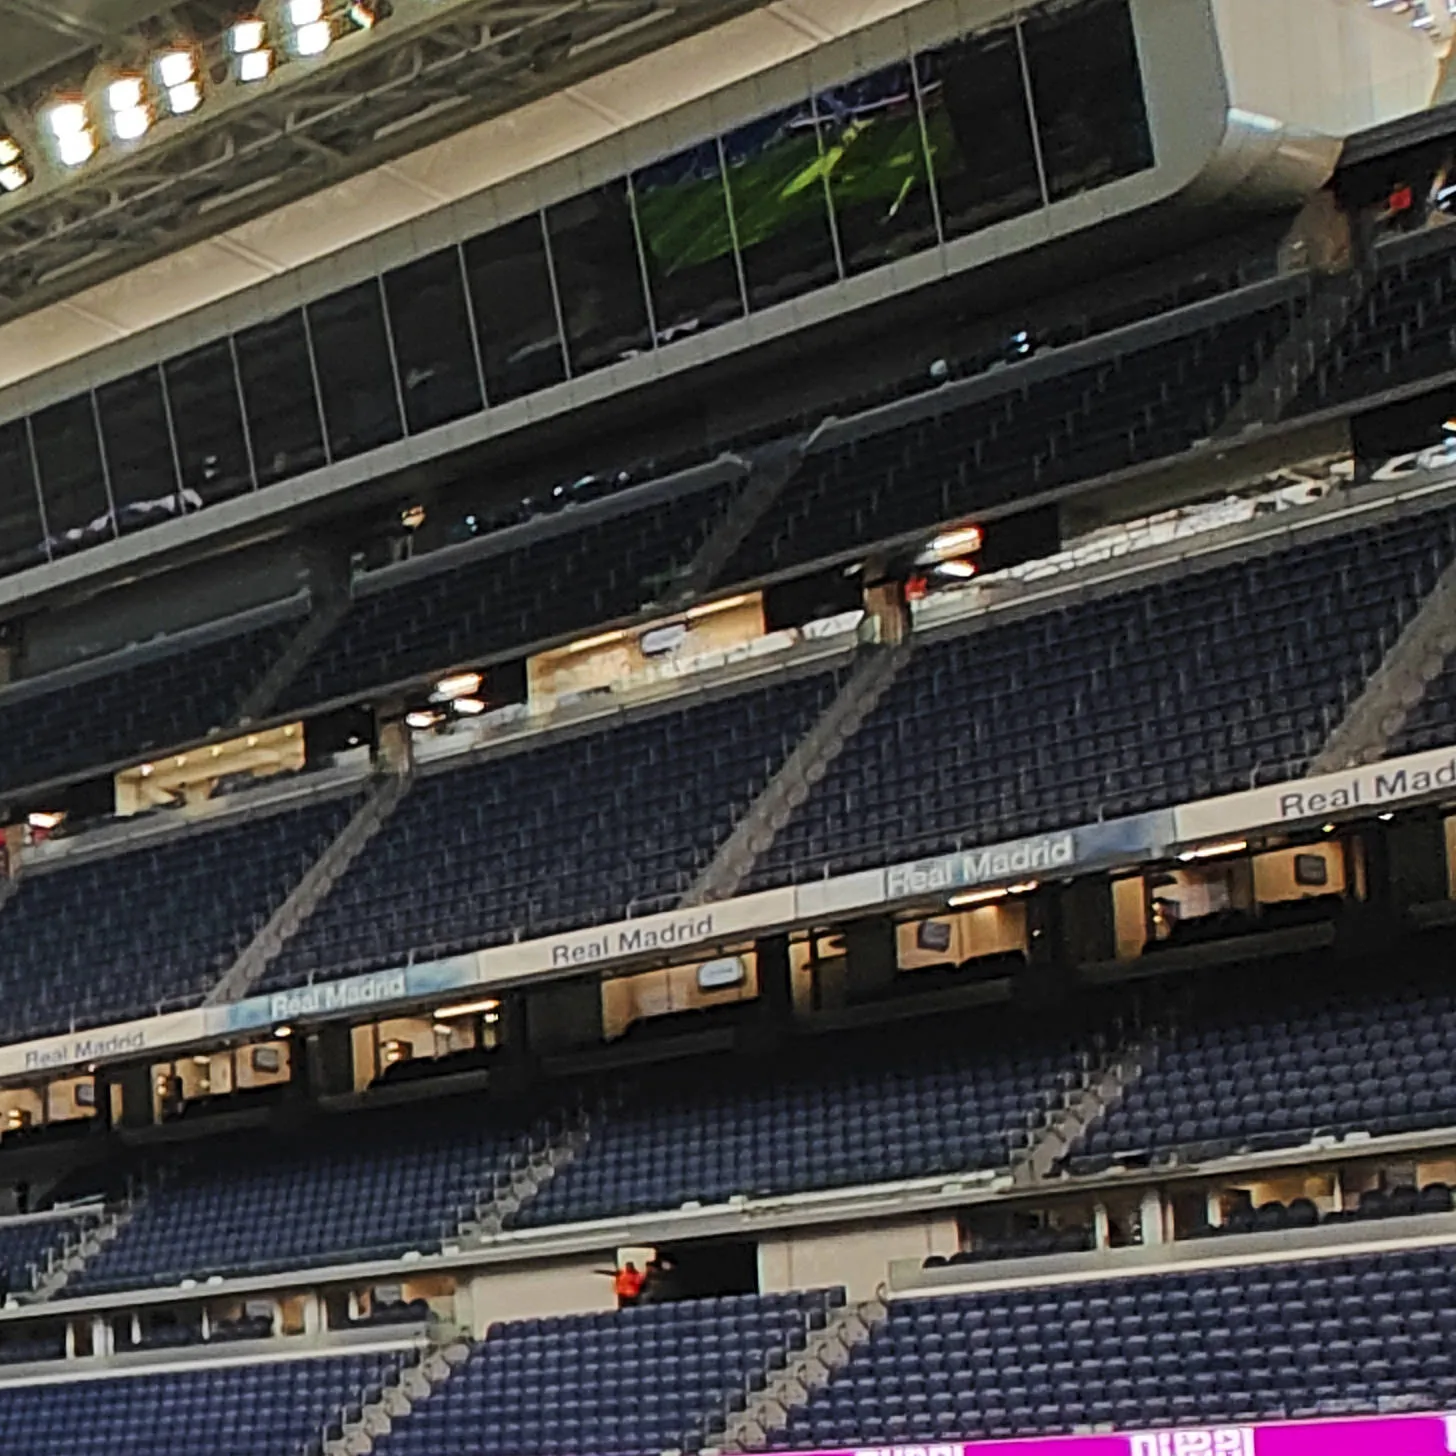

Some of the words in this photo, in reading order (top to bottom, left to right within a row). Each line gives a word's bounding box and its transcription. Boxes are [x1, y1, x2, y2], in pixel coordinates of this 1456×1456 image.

[1279, 779, 1360, 817] Real
[888, 859, 953, 897] Real
[962, 834, 1075, 881] Madrid
[552, 936, 608, 967] Real
[618, 914, 713, 952] Madrid
[271, 987, 319, 1021] Real
[325, 969, 407, 1007] Madrid
[25, 1047, 68, 1067] Real
[74, 1031, 145, 1059] Madrid
